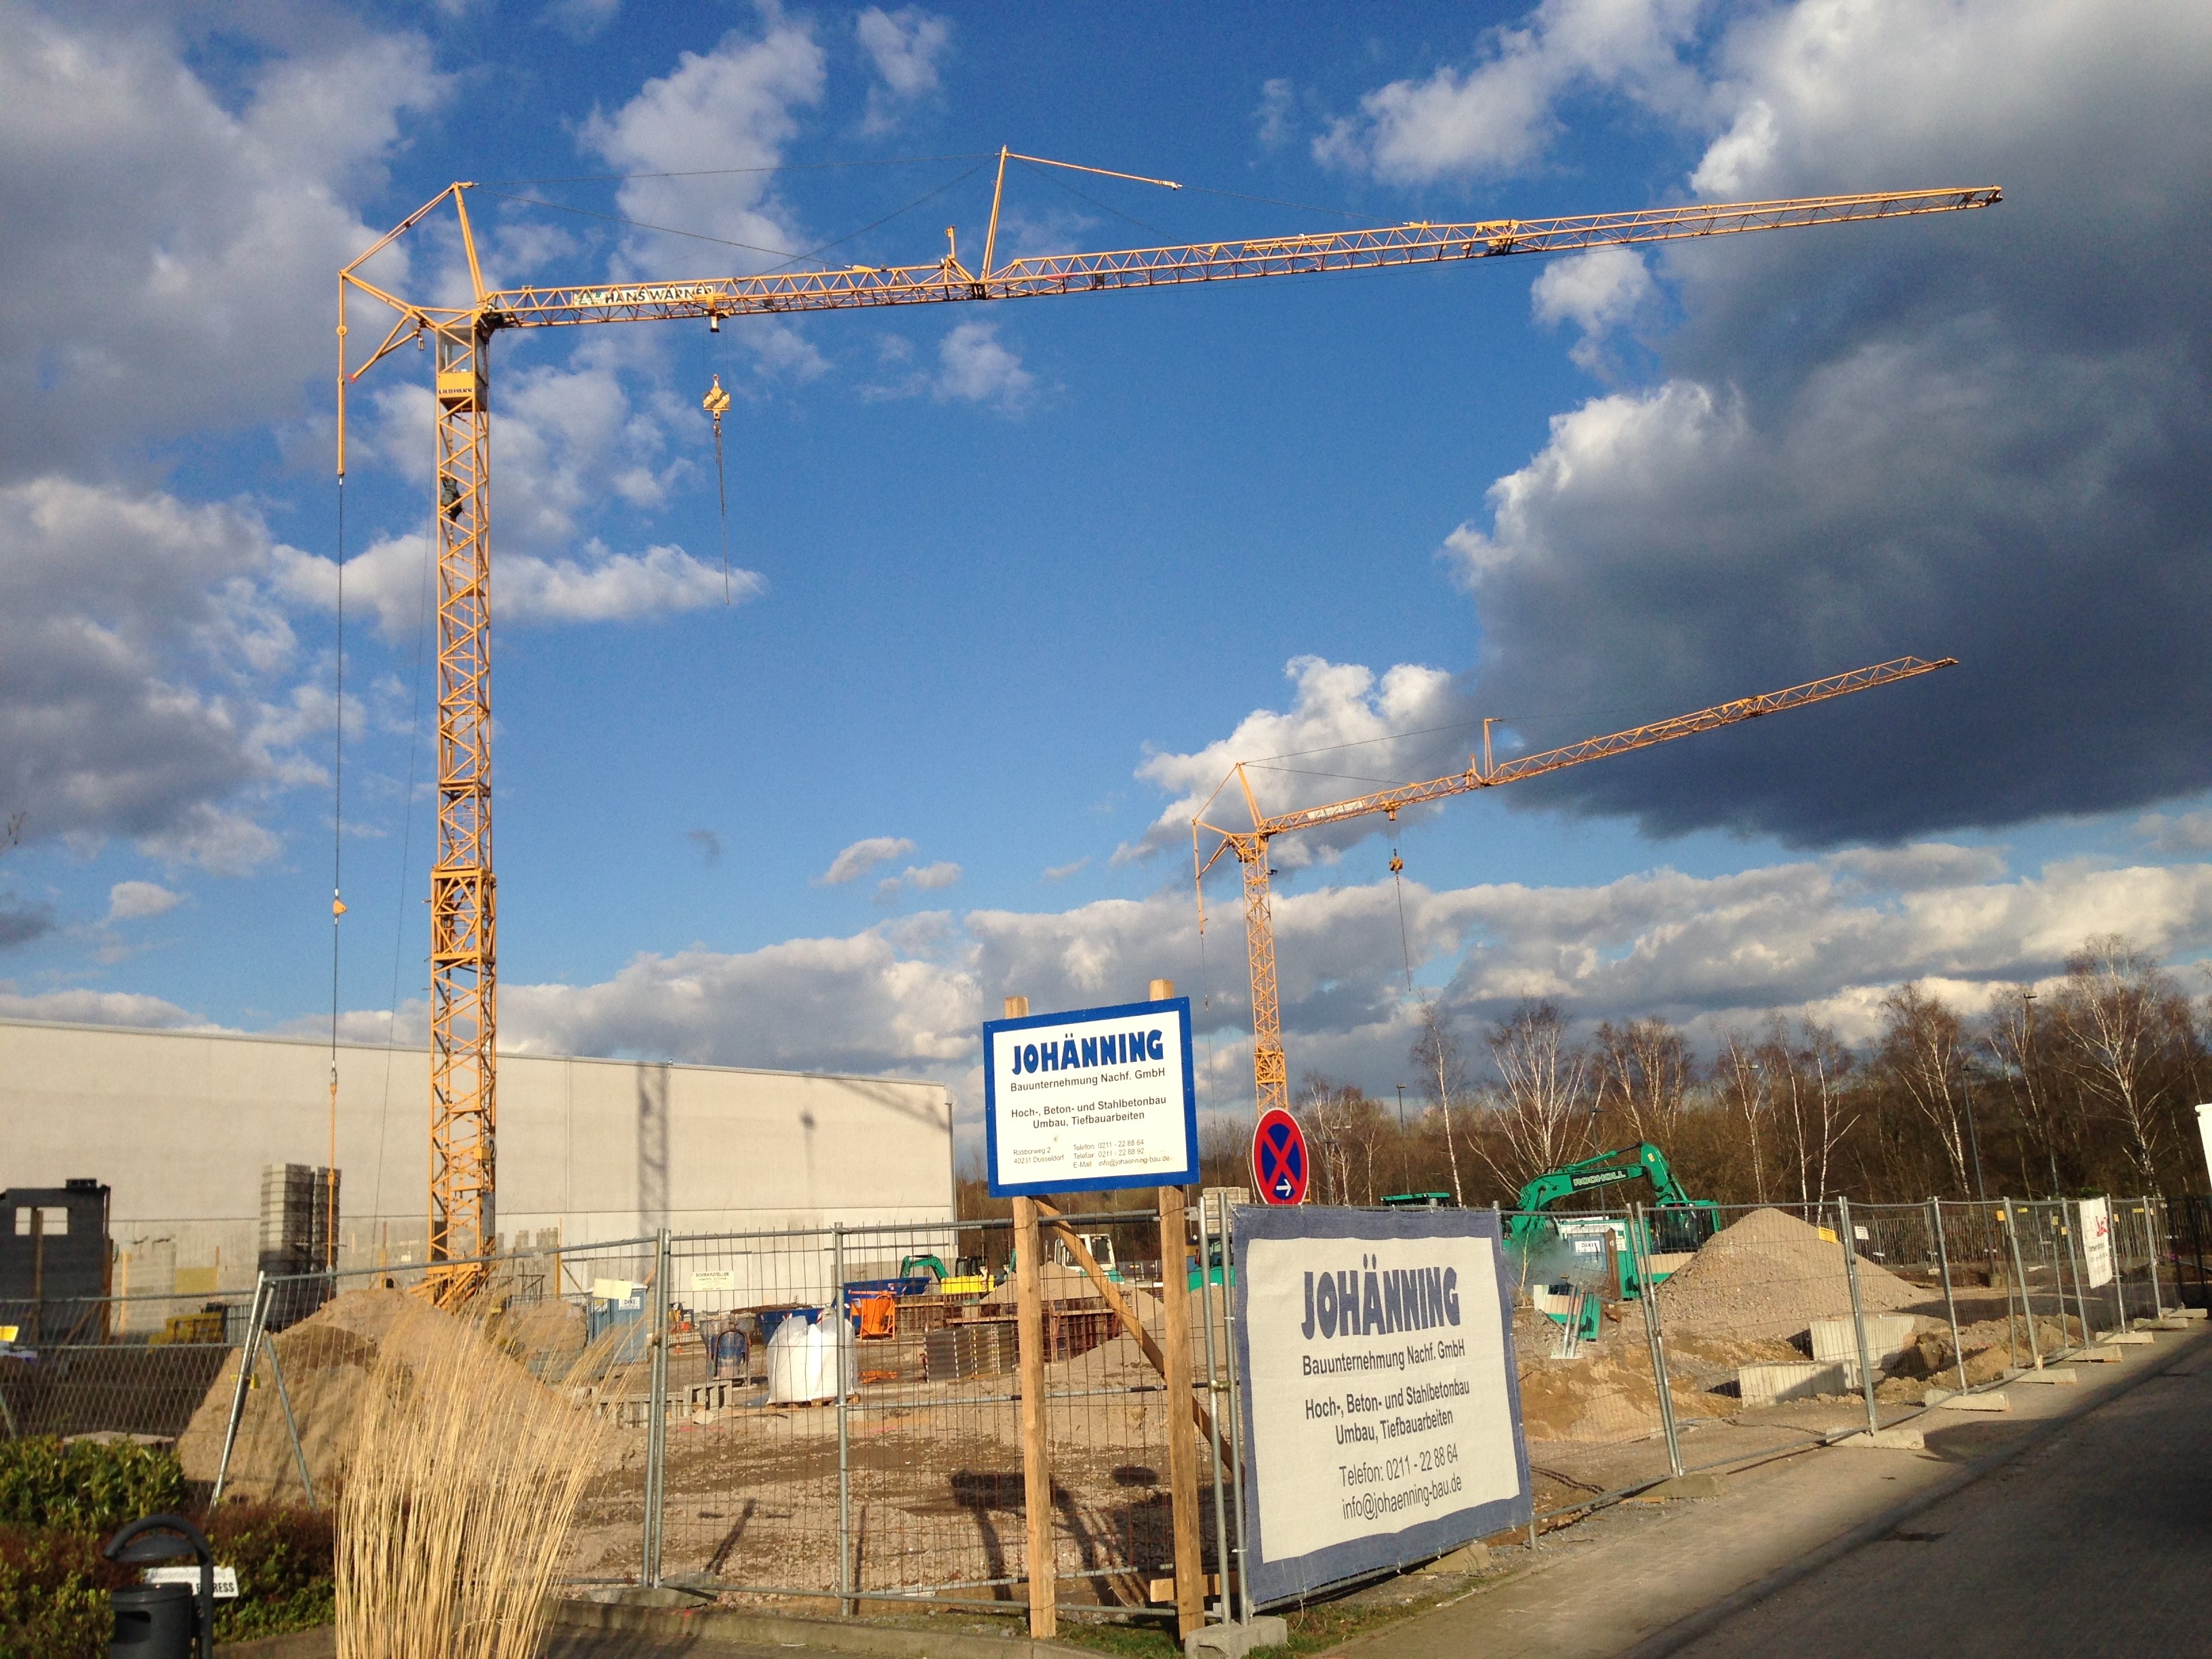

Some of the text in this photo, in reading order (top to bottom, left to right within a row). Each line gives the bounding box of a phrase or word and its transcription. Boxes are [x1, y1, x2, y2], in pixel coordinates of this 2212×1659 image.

[605, 290, 645, 304] HANS
[1011, 1029, 1164, 1075] JOHÄNNING
[1010, 1067, 1165, 1092] Bauunternehmung Nachf. GmbH
[1011, 1096, 1166, 1118] Hoch-, Beton- und Stahlbetonbau
[1033, 1111, 1145, 1128] Umbau, Tiefbauarbeiten
[1573, 1170, 1626, 1186] ROCHOLL
[1301, 1253, 1460, 1340] JOHÄNNING
[1303, 1338, 1465, 1376] Bauunternehmung Nachf. GmbH
[1305, 1378, 1470, 1419] Hoch-, Beton- und Stahlbetonbau
[1335, 1408, 1454, 1445] Umbau, Tiefbauarbeiten
[1339, 1462, 1384, 1487] Telefon:
[1387, 1455, 1410, 1480] 0211
[1420, 1450, 1433, 1471] 22
[1433, 1446, 1446, 1468] 88
[1447, 1442, 1458, 1464] 64
[1342, 1472, 1462, 1520] info@johaenning-bau.de
